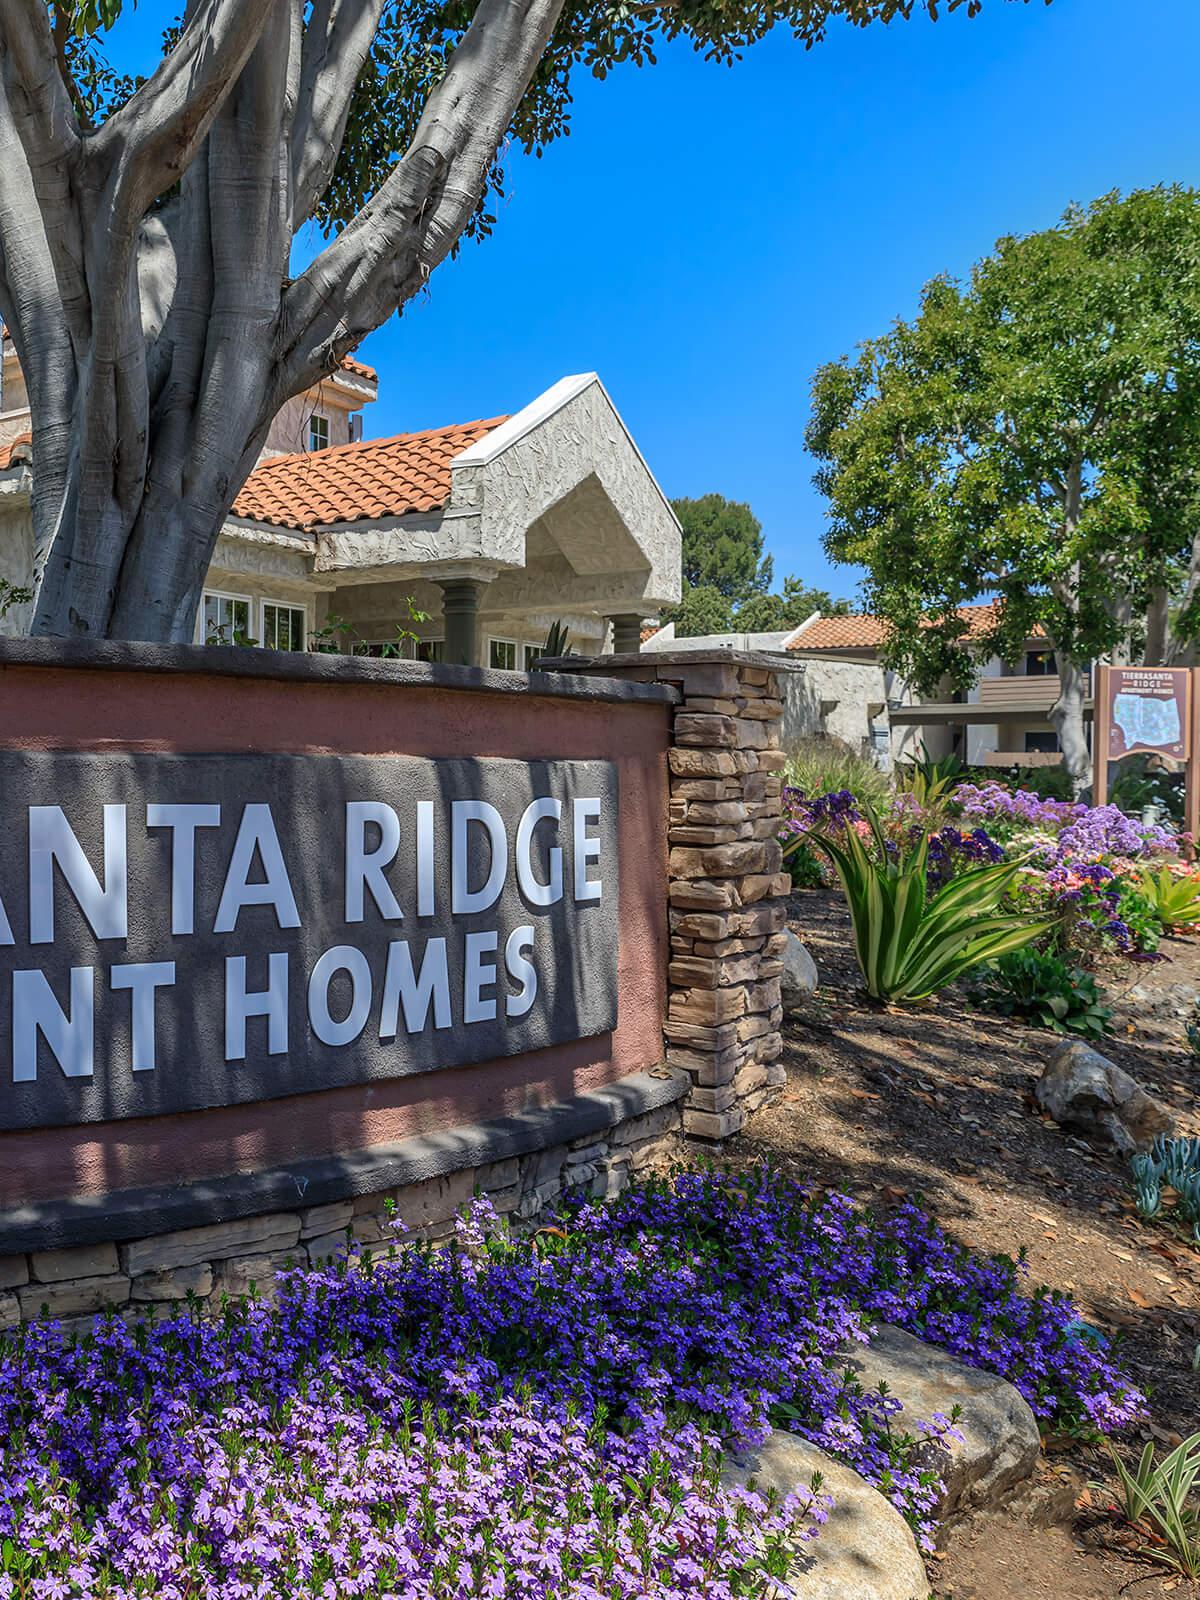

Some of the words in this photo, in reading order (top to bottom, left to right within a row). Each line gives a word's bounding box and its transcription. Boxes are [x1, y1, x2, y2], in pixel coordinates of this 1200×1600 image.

[1133, 680, 1161, 688] RIDGE
[345, 797, 602, 924] RIDGE
[225, 926, 537, 1061] HOMES
